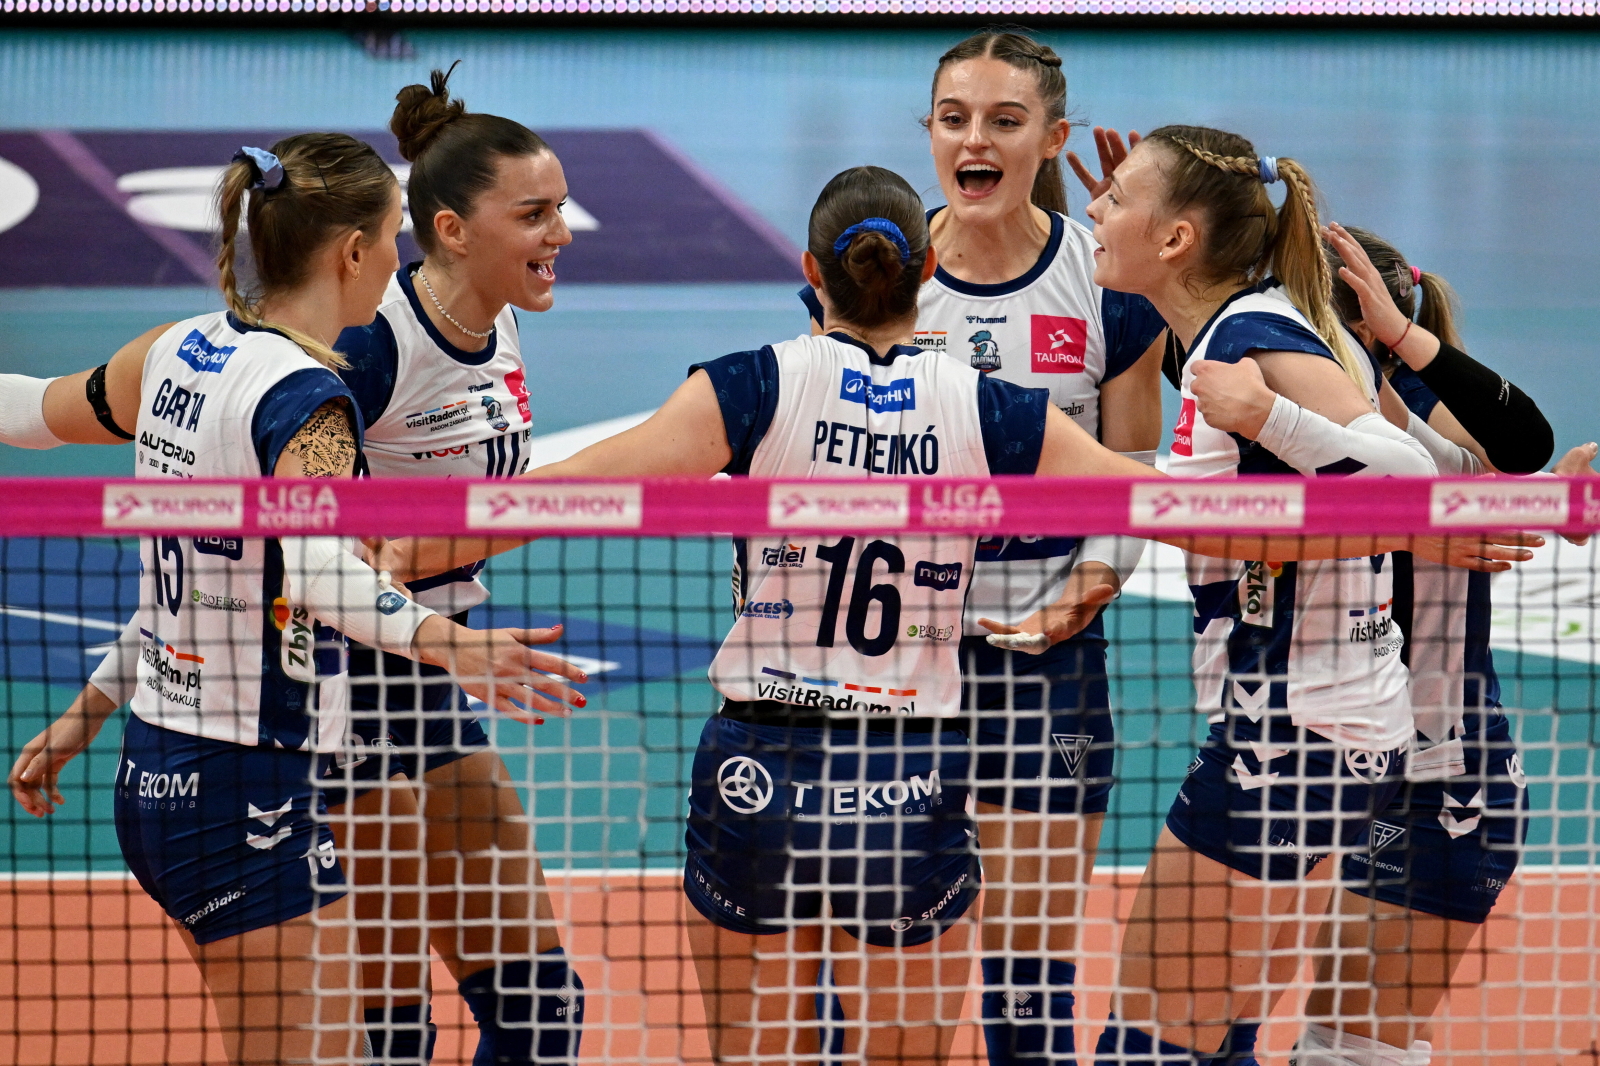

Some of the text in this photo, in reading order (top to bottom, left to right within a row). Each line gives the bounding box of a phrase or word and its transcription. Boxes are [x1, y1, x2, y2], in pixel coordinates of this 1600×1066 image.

[976, 315, 1007, 324] hummel
[151, 496, 235, 515] TAURON
[258, 485, 339, 511] LIGA
[527, 495, 625, 515] TAURON
[817, 497, 900, 515] TAURON
[922, 484, 1003, 509] LIGA
[1188, 495, 1286, 515] TAURON
[1477, 495, 1561, 514] TAURON
[257, 511, 339, 529] KOBIET
[920, 567, 958, 584] moya
[815, 536, 906, 657] 16
[1375, 861, 1404, 874] BRONI
[1002, 1006, 1033, 1016] erea
